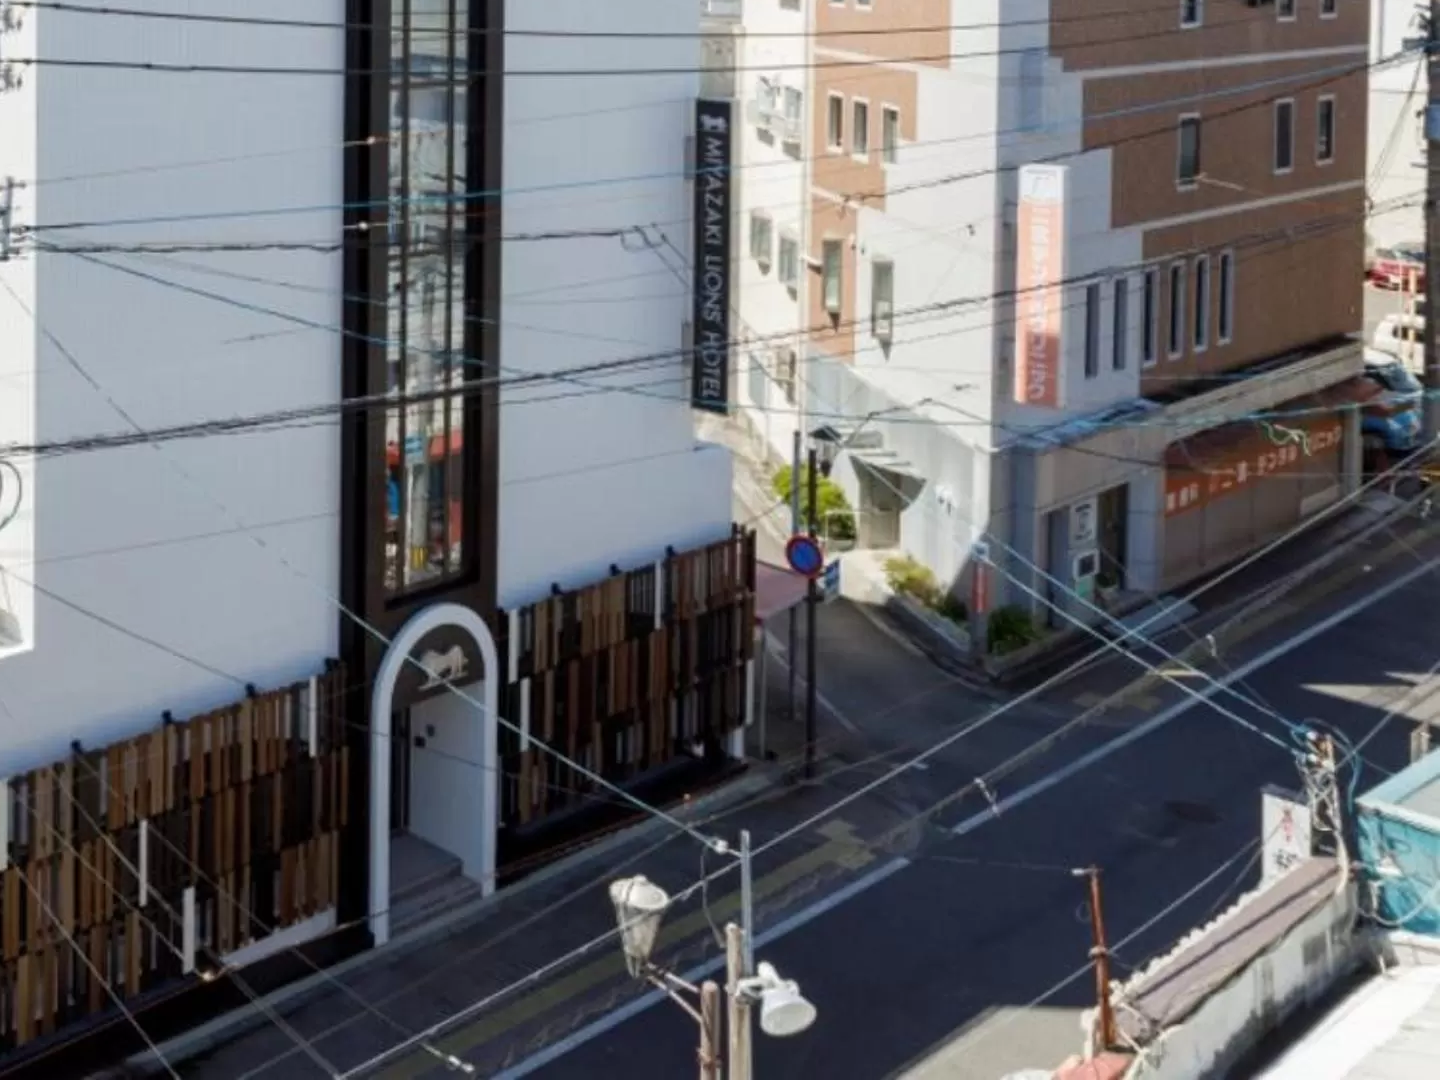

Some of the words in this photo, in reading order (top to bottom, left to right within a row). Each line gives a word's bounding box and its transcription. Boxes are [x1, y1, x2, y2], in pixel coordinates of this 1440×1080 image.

[703, 138, 723, 246] MIYAZAKI
[703, 255, 723, 322] LIONS
[701, 331, 721, 398] HOTEL
